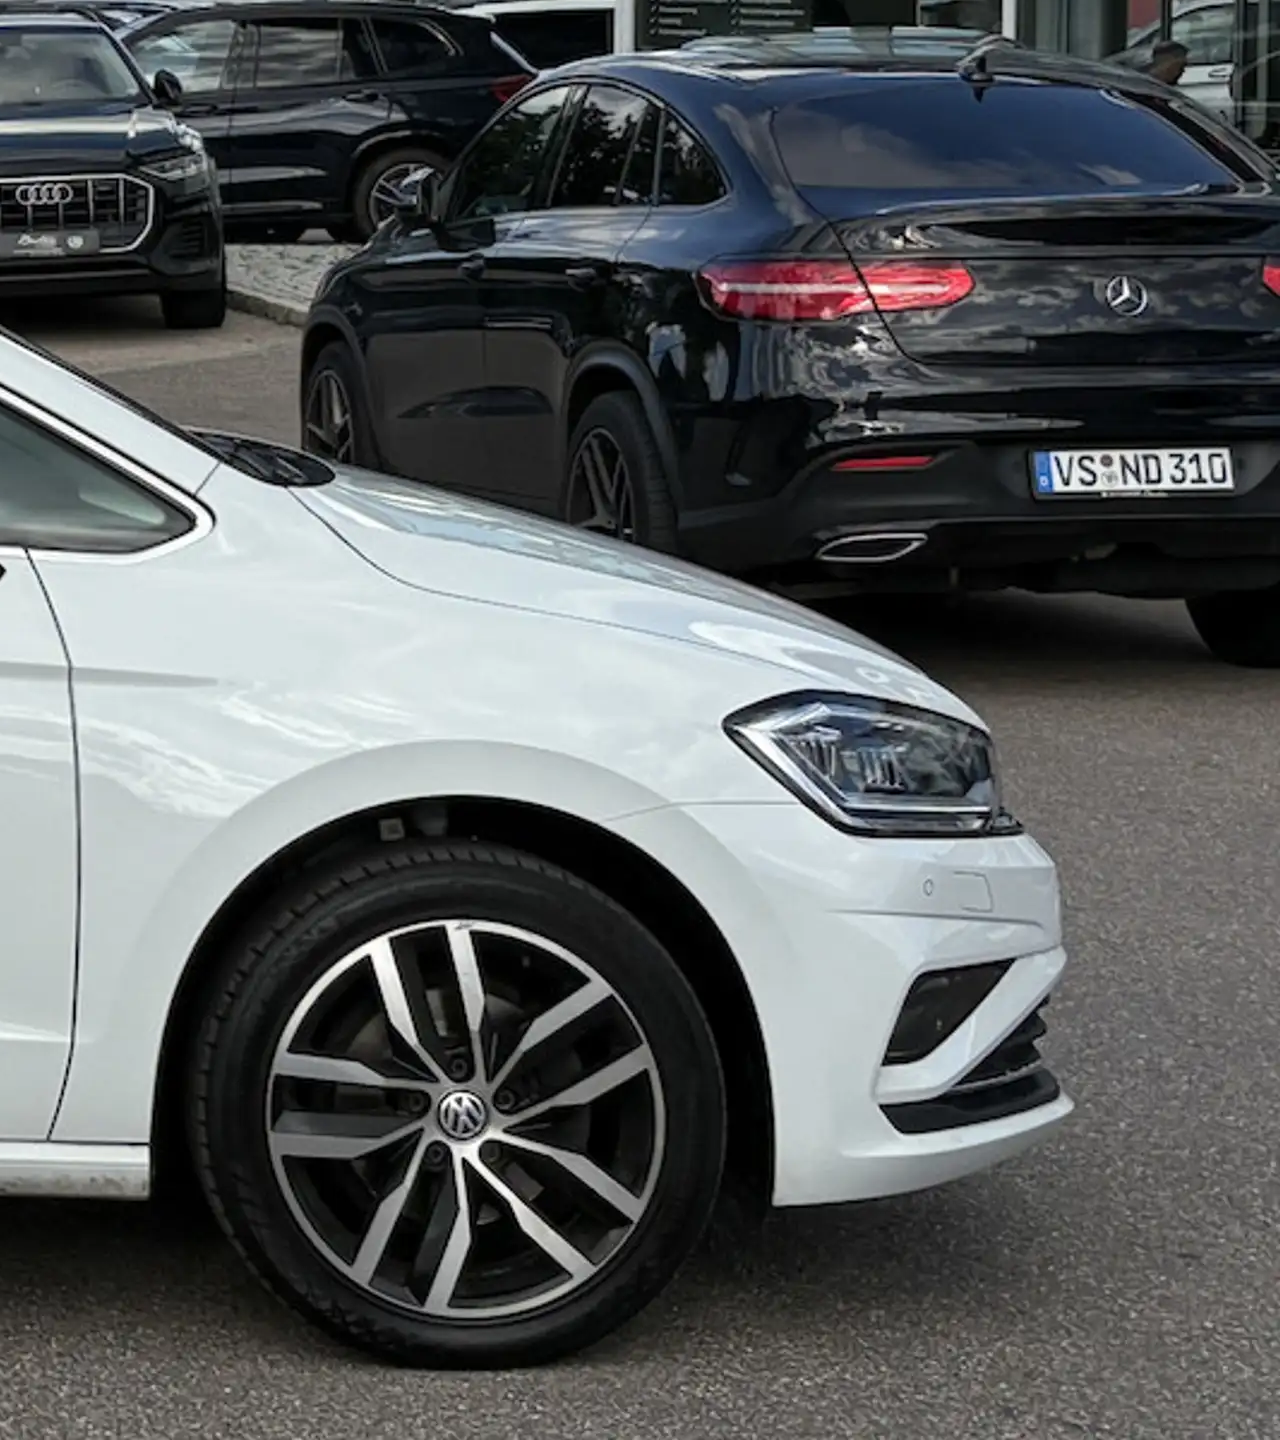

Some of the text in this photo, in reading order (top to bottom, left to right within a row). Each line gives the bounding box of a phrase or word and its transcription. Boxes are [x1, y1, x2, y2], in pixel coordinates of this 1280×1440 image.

[1054, 452, 1227, 487] VS ND 310
